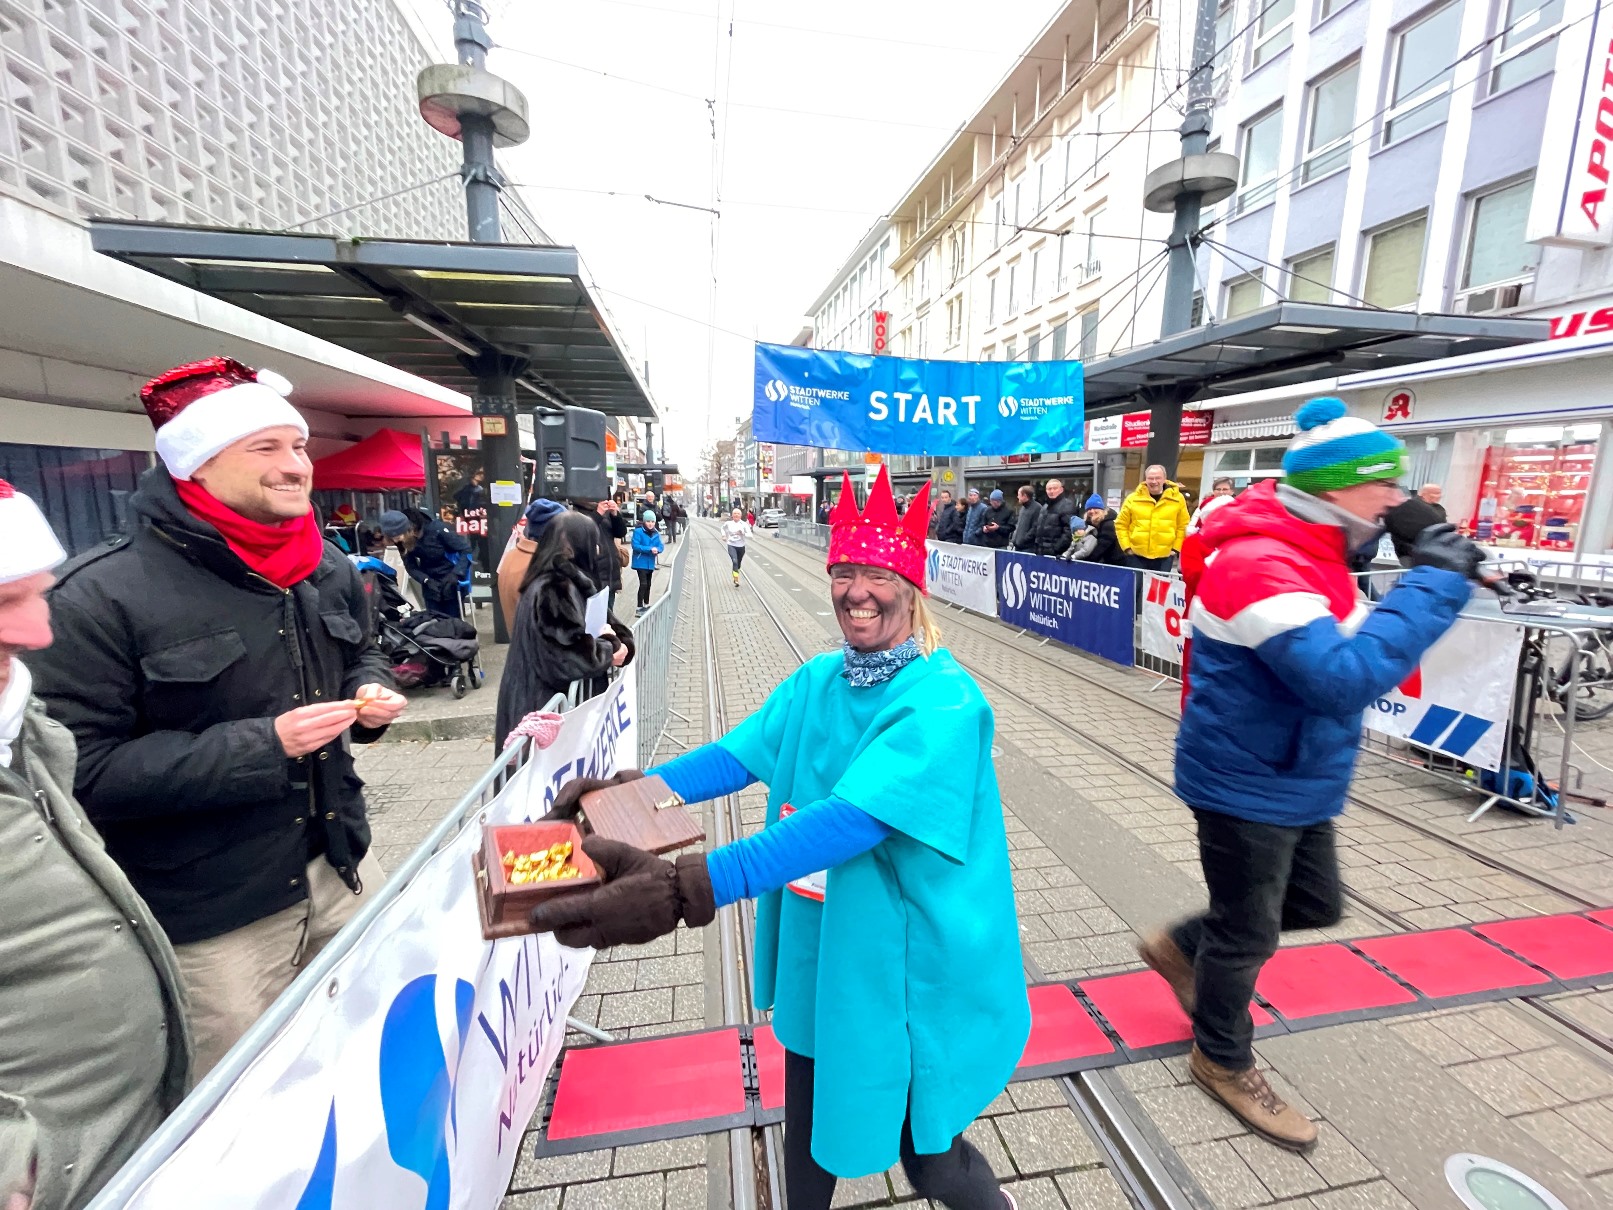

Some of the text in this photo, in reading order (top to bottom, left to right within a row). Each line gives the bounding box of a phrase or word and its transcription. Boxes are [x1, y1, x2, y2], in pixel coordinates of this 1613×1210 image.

[874, 311, 887, 353] WOO
[789, 385, 850, 400] STADTWERKE
[790, 393, 820, 406] WITTEN
[1020, 396, 1074, 406] STADTWERKE
[868, 390, 981, 426] START
[1020, 407, 1048, 415] WITTEN
[941, 554, 988, 577] STADTWERKE
[941, 570, 963, 587] WITTEN
[1030, 571, 1120, 609] STADTWERKE
[1030, 591, 1073, 619] WITTEN
